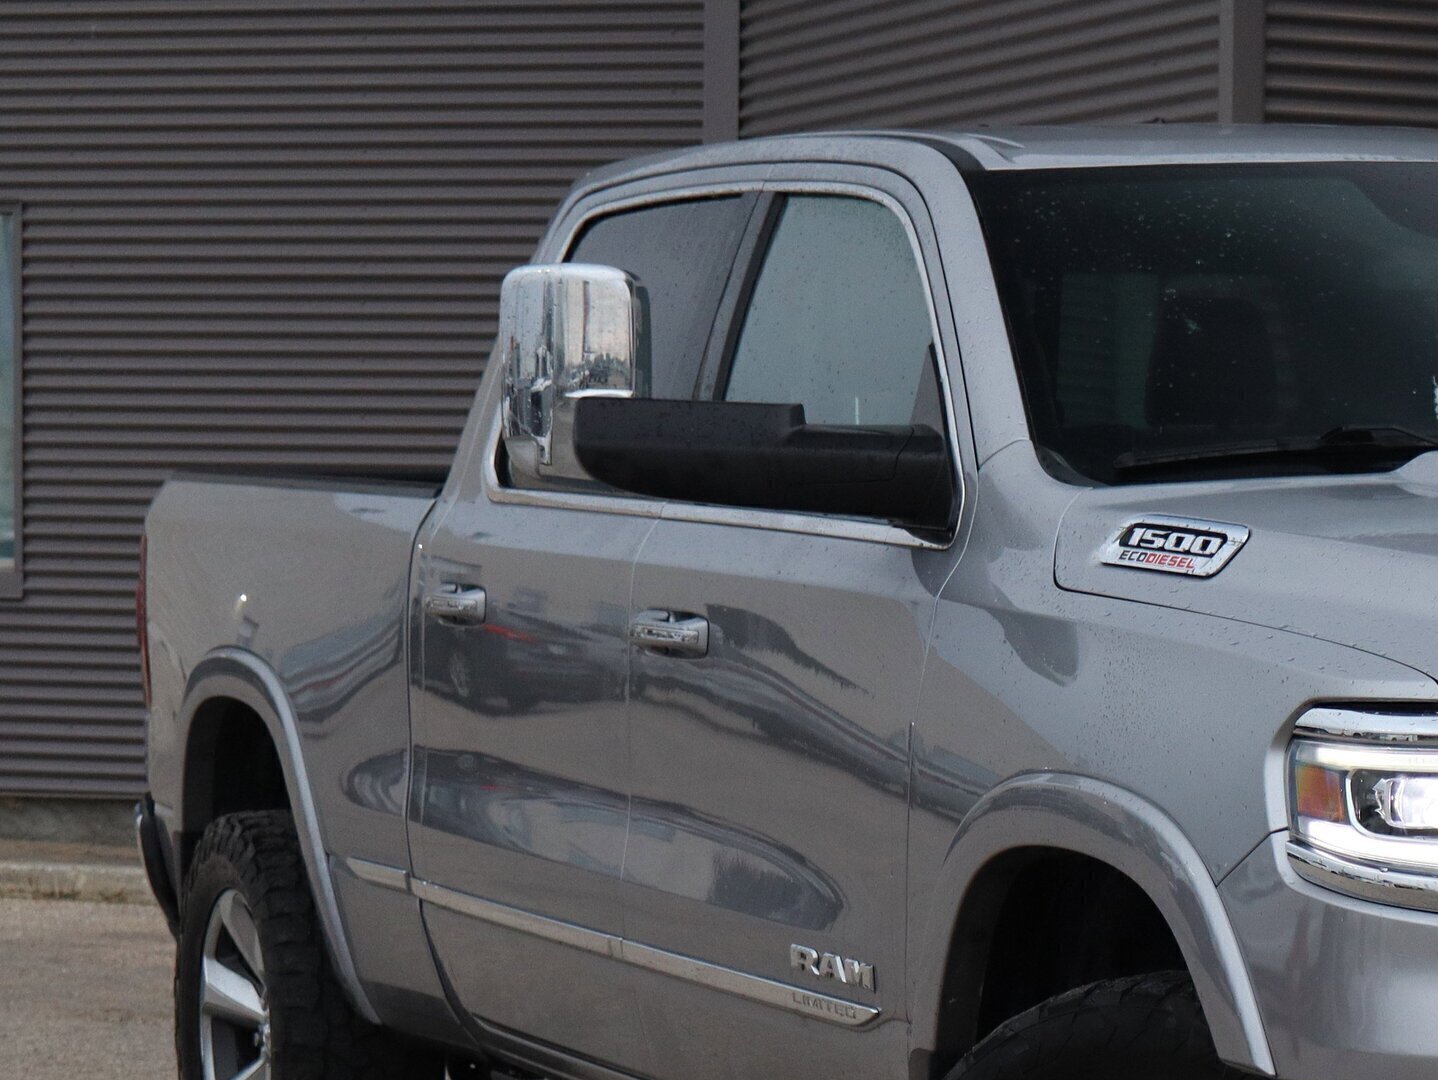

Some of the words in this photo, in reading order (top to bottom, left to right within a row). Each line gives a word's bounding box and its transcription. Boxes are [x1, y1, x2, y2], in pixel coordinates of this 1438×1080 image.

[1127, 527, 1223, 555] 1500
[1118, 550, 1196, 569] ECODIESEL
[790, 943, 876, 993] RAM
